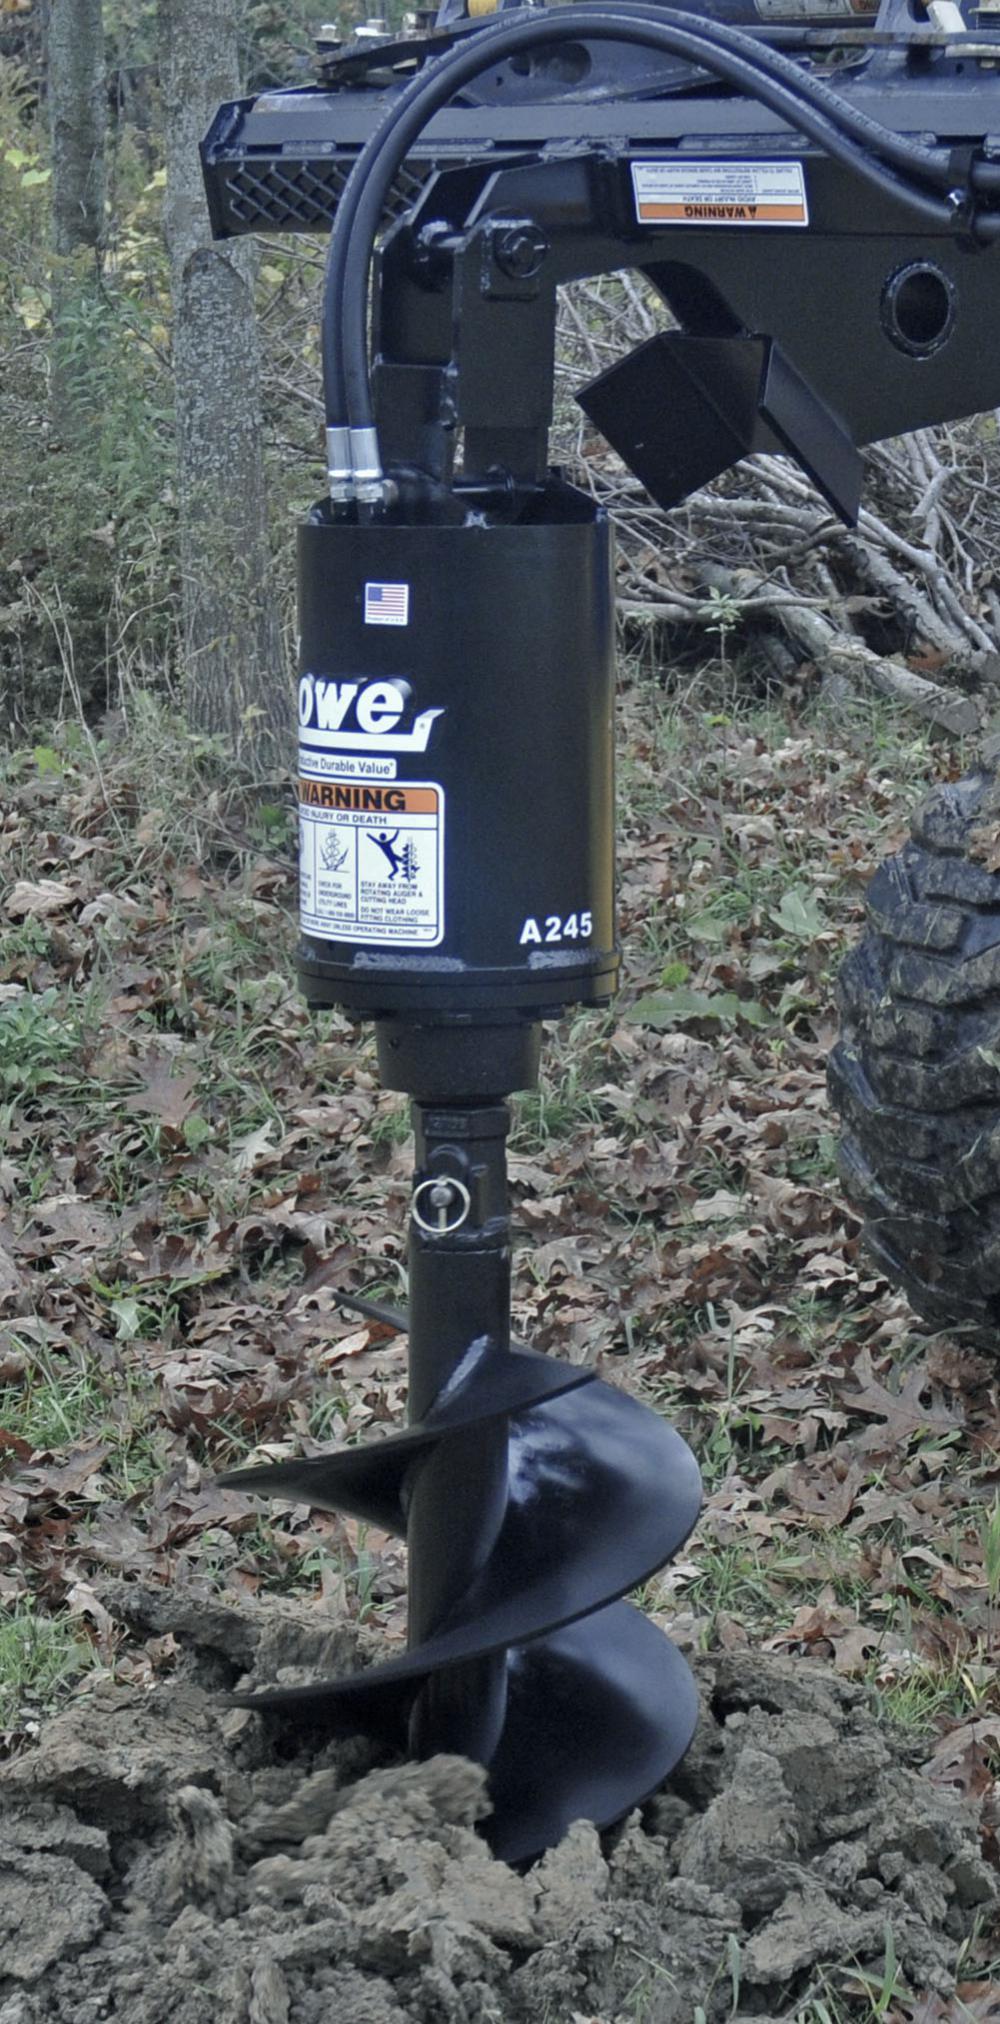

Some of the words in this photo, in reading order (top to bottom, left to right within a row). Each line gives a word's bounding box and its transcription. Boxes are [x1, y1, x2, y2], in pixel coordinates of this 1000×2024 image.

[684, 206, 746, 218] WARNING
[299, 677, 405, 734] owe
[320, 758, 356, 773] Durable
[300, 781, 406, 811] WARNING
[312, 810, 334, 821] INJURY
[336, 812, 350, 822] OR
[352, 814, 388, 825] DEATH
[377, 882, 396, 890] AWAY
[360, 889, 391, 897] ROTATING
[393, 890, 417, 898] AUGER
[360, 896, 387, 904] CUTTING
[360, 914, 383, 922] FITTING
[353, 925, 387, 934] OPERATING
[519, 911, 593, 945] A245
